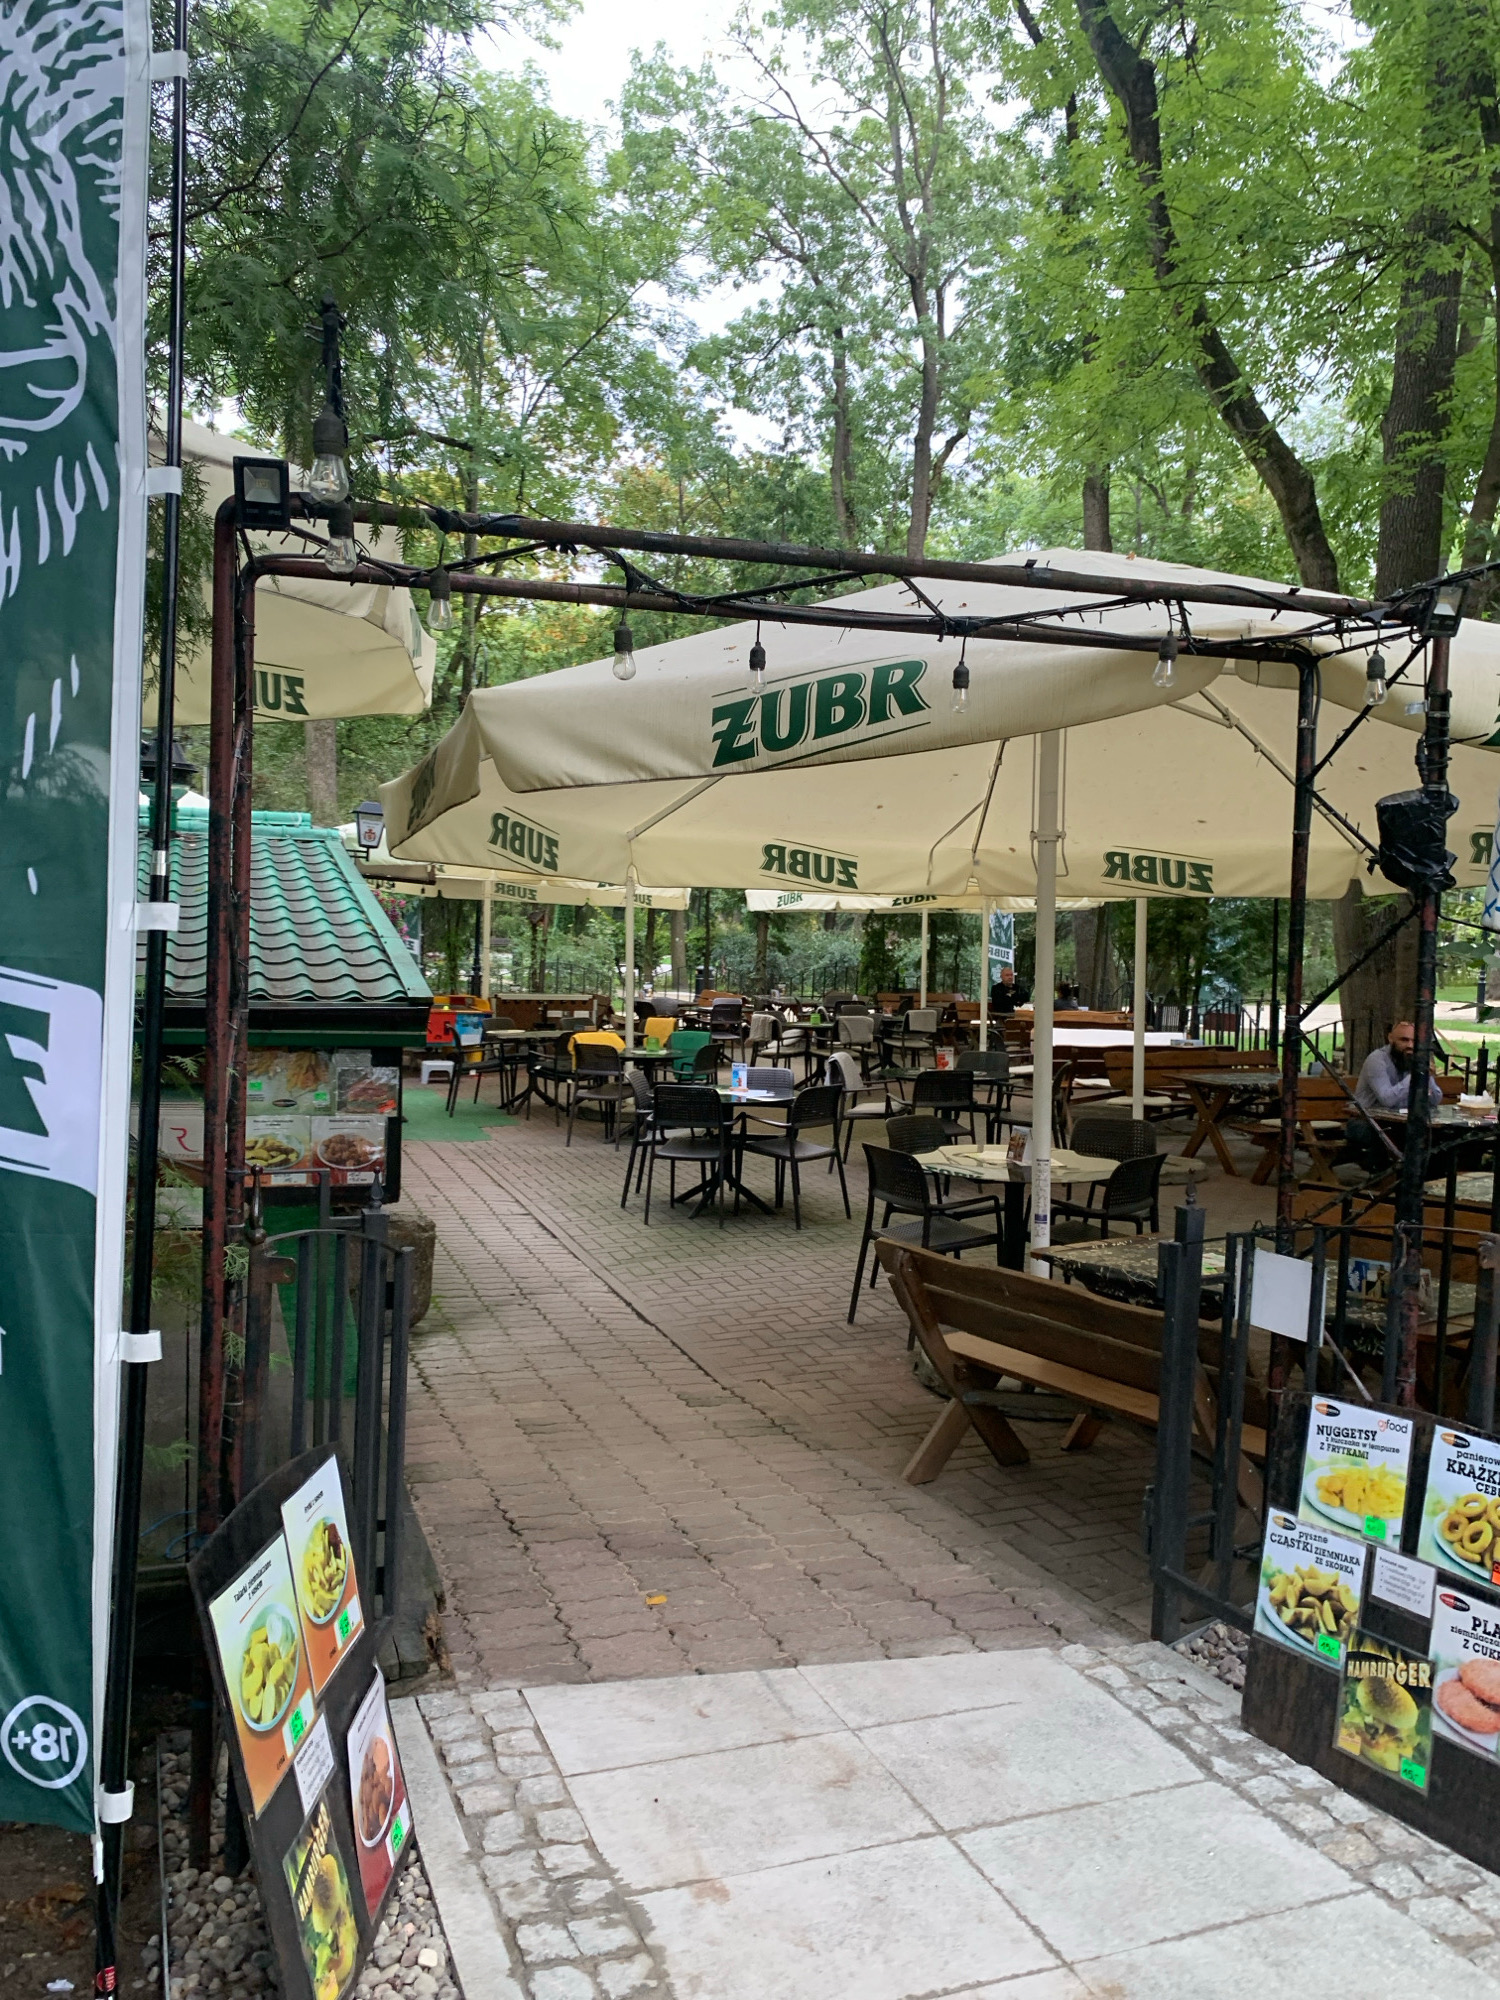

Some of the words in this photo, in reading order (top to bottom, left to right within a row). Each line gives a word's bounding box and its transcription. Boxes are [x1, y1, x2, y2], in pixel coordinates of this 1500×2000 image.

[1316, 1424, 1378, 1442] NUGGETSY
[1330, 1436, 1360, 1448] kurczaka
[1319, 1442, 1325, 1450] Z
[1326, 1443, 1370, 1460] FRYTKAMI
[1298, 1531, 1328, 1544] pyszne
[1314, 1547, 1361, 1567] ZIEMNIAKA
[1315, 1557, 1324, 1566] ZE
[1325, 1559, 1355, 1577] SKÓRKĄ
[1463, 1638, 1470, 1649] Z
[1347, 1659, 1431, 1688] HAMBURGER
[297, 1801, 331, 1922] HAMBURGER
